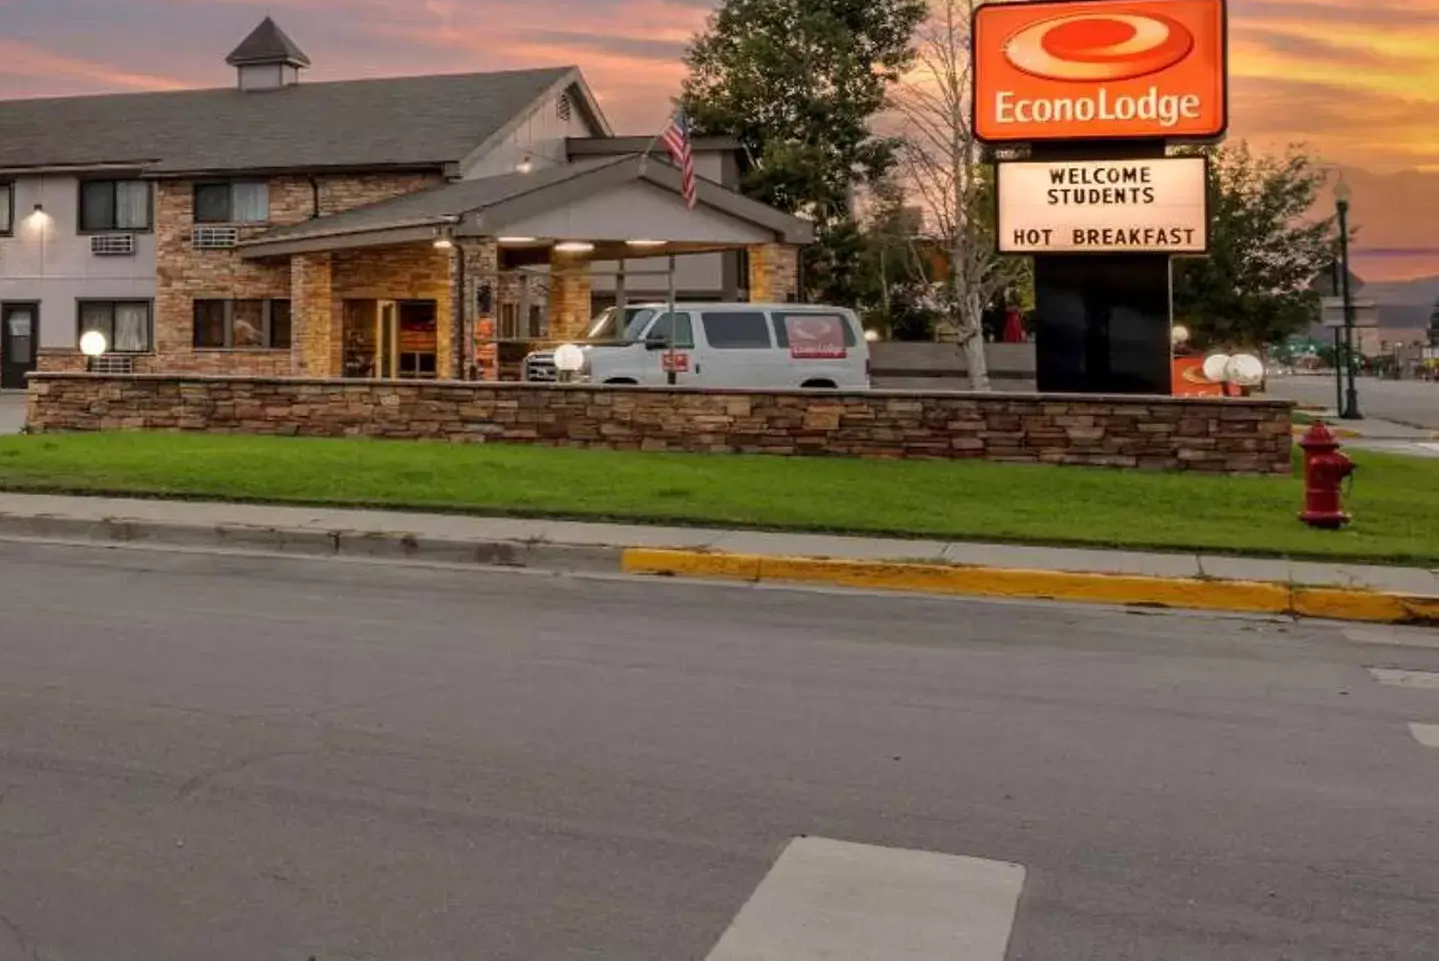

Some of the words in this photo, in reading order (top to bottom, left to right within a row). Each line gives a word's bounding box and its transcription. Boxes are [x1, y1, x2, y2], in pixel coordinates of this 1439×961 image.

[1049, 167, 1151, 184] WELCOME
[1047, 188, 1155, 205] STUDENTS
[1013, 229, 1053, 246] HOT
[1073, 228, 1196, 245] BREAKFAST
